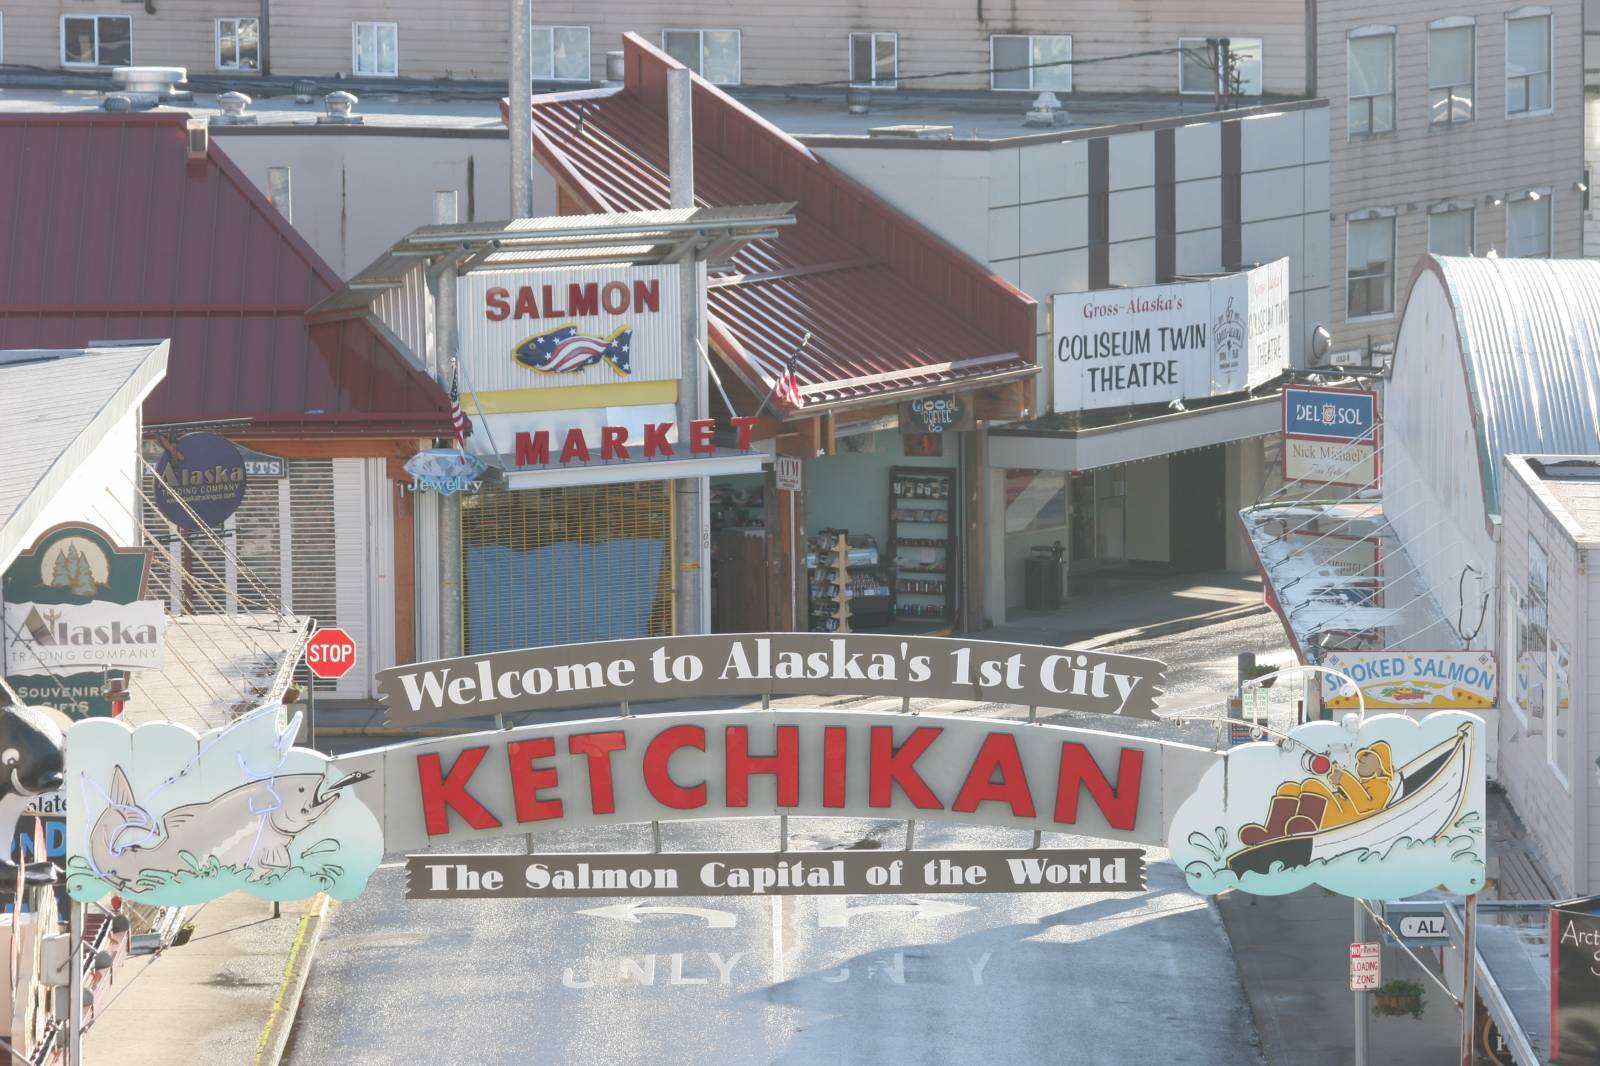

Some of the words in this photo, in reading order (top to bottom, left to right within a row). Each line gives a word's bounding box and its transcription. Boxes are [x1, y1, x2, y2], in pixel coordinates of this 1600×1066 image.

[485, 279, 659, 321] SALMON
[1083, 295, 1183, 319] Gross-Alaska's
[1058, 328, 1150, 362] COLISEUM
[1158, 323, 1206, 352] TWIN
[1087, 360, 1179, 393] THEATRE
[1296, 404, 1320, 422] DEL
[1338, 407, 1363, 425] SOL
[515, 416, 757, 466] MARKET
[1293, 444, 1316, 459] Nick
[159, 462, 244, 487] Alaska
[407, 476, 483, 493] Jewelry
[162, 487, 198, 496] TRDING
[200, 483, 240, 494] COMPANY
[11, 605, 157, 648] Alaska
[12, 651, 76, 663] TRADING
[83, 649, 158, 660] COMPANY
[309, 644, 352, 663] STOP
[398, 659, 635, 712] Welcome
[649, 646, 703, 683] to
[717, 638, 932, 682] Alaska's
[950, 647, 1025, 690] 1st
[1040, 654, 1143, 714] City
[1325, 657, 1405, 691] SMOKED
[1413, 657, 1495, 690] SALMON
[417, 724, 1144, 835] KETCHIKAN
[425, 864, 504, 891] The
[525, 862, 679, 890] Salmon
[700, 860, 846, 894] Capital
[865, 859, 903, 886] of
[922, 859, 987, 886] the
[1006, 857, 1128, 885] World
[1352, 946, 1360, 954] NO
[1353, 961, 1378, 971] LOADING
[1356, 975, 1375, 984] ZONE
